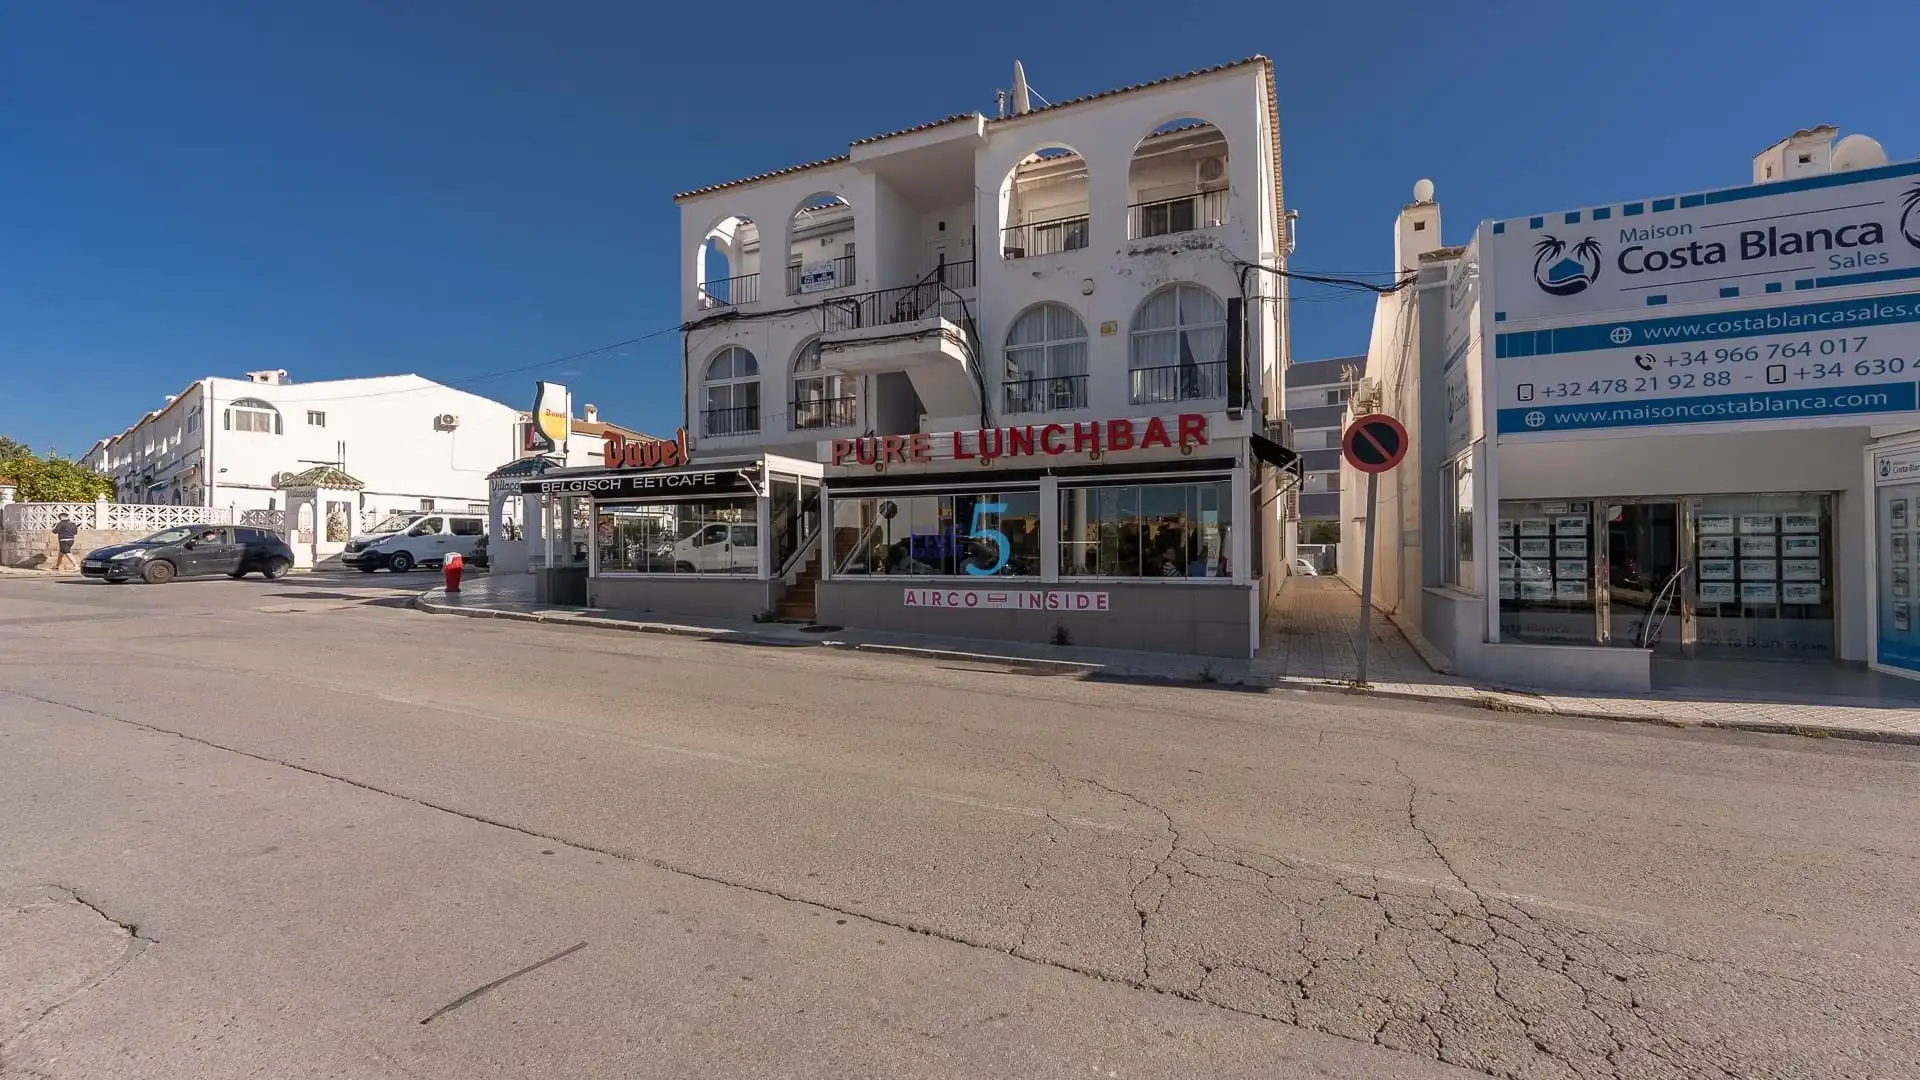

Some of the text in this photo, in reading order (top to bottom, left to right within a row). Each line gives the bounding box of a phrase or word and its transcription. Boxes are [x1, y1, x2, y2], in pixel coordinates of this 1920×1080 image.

[1617, 222, 1884, 274] Costa Blanca
[1619, 223, 1692, 243] Maison
[1828, 251, 1889, 270] Sales
[1664, 336, 1868, 367] +34 966 764 017
[1541, 382, 1581, 398] +32
[1587, 379, 1627, 395] 478
[1634, 377, 1657, 392] 21
[1668, 374, 1695, 389] 92
[1703, 371, 1731, 387] 88
[1794, 362, 1844, 380] +34
[1854, 357, 1904, 376] 630
[546, 408, 566, 418] Duvel
[1554, 393, 1887, 424] www.maisoncostablanca.com
[602, 427, 689, 469] Duvel
[832, 414, 1208, 466] PURE LUNCHBAR
[542, 474, 716, 493] BELGISCH EETCAFE
[905, 591, 1107, 609] AIRCO INSIDE
